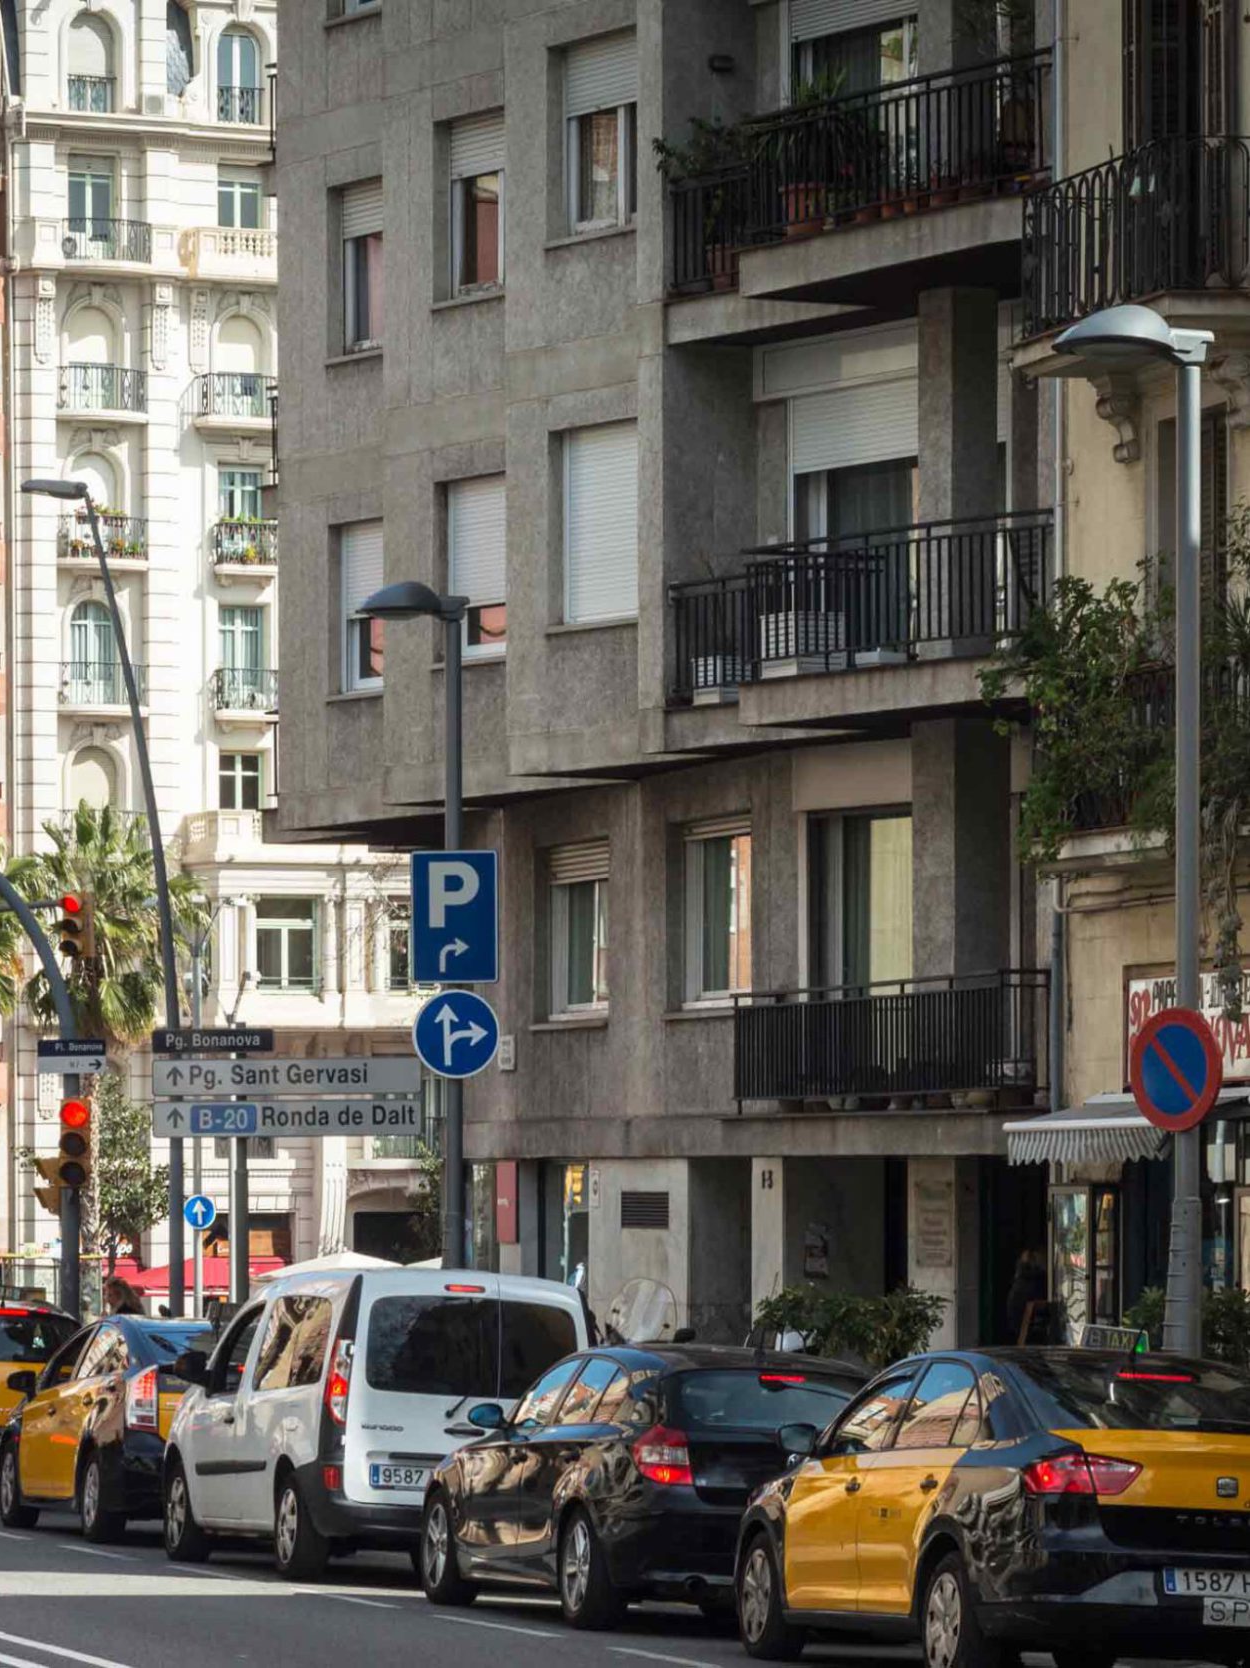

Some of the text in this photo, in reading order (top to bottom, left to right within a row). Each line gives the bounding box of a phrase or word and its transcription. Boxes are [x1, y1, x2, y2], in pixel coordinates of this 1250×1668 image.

[429, 862, 479, 927] P
[166, 1033, 260, 1049] Pg. Bonanova
[190, 1063, 368, 1090] Pg. Sant Gervasi
[200, 1104, 415, 1129] B-20 Ronda de Dalt
[383, 1468, 424, 1485] 9587
[1183, 1572, 1235, 1593] 1587
